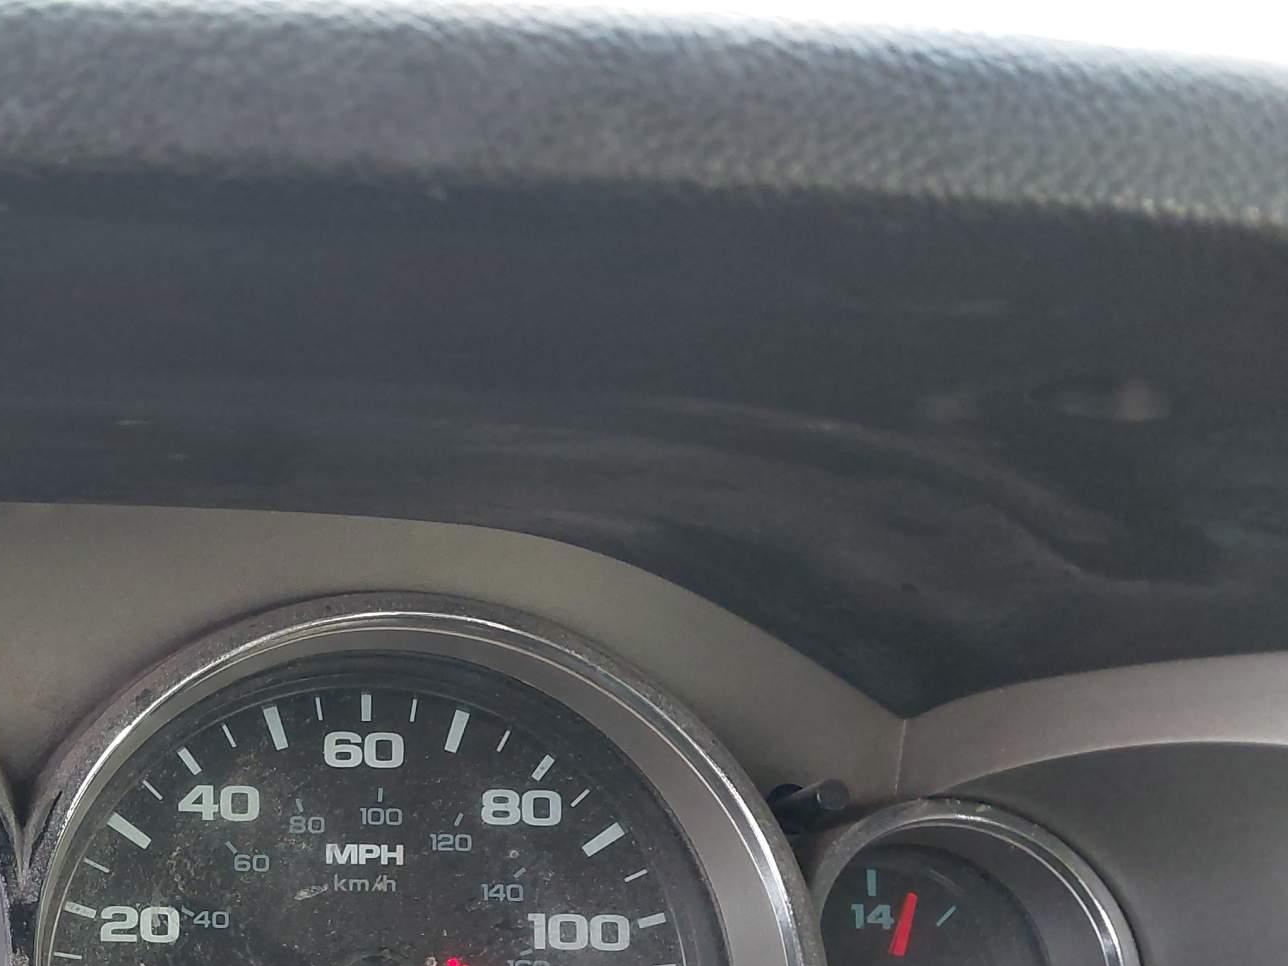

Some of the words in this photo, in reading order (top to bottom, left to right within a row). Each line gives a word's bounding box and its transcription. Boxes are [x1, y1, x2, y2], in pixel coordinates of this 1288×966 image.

[322, 731, 405, 769] 60
[178, 784, 261, 822] 40
[480, 789, 562, 828] 80
[288, 815, 326, 834] 80
[360, 807, 403, 826] 100
[430, 833, 473, 852] 120
[233, 853, 270, 873] 60
[325, 843, 404, 866] MPH
[333, 874, 397, 893] km/h
[480, 883, 524, 902] 140
[100, 906, 180, 944] 20
[192, 910, 230, 929] 40
[851, 903, 895, 930] 14
[527, 913, 630, 951] 100
